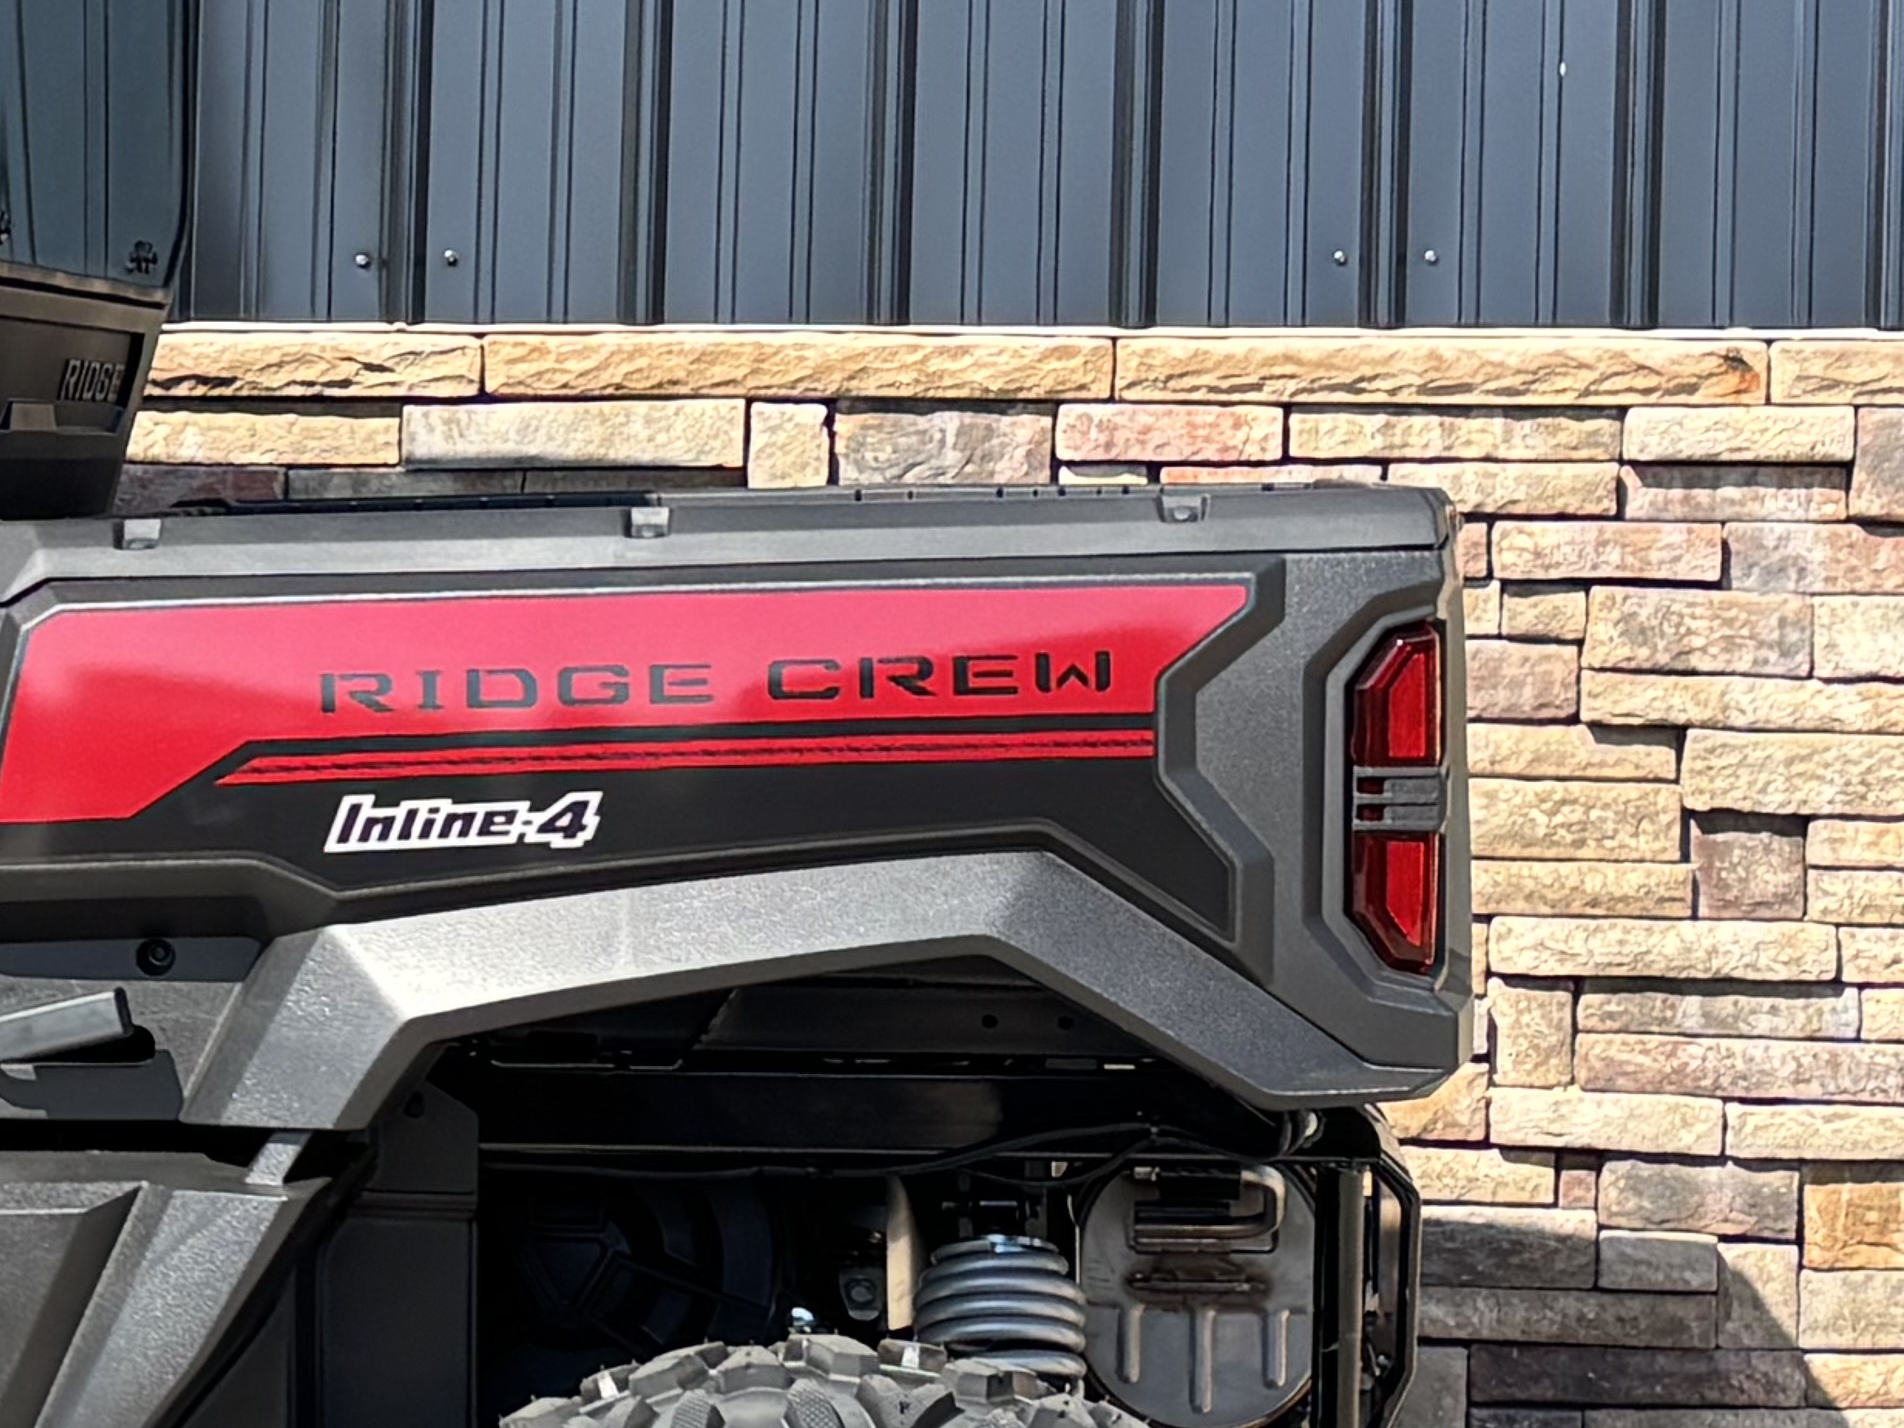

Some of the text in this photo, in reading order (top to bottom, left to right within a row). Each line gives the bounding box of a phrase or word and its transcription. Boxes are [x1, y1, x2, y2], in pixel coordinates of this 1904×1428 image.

[59, 359, 126, 403] RIDGE
[320, 650, 1112, 713] RIDGE CREW
[331, 795, 596, 849] Inline-4
